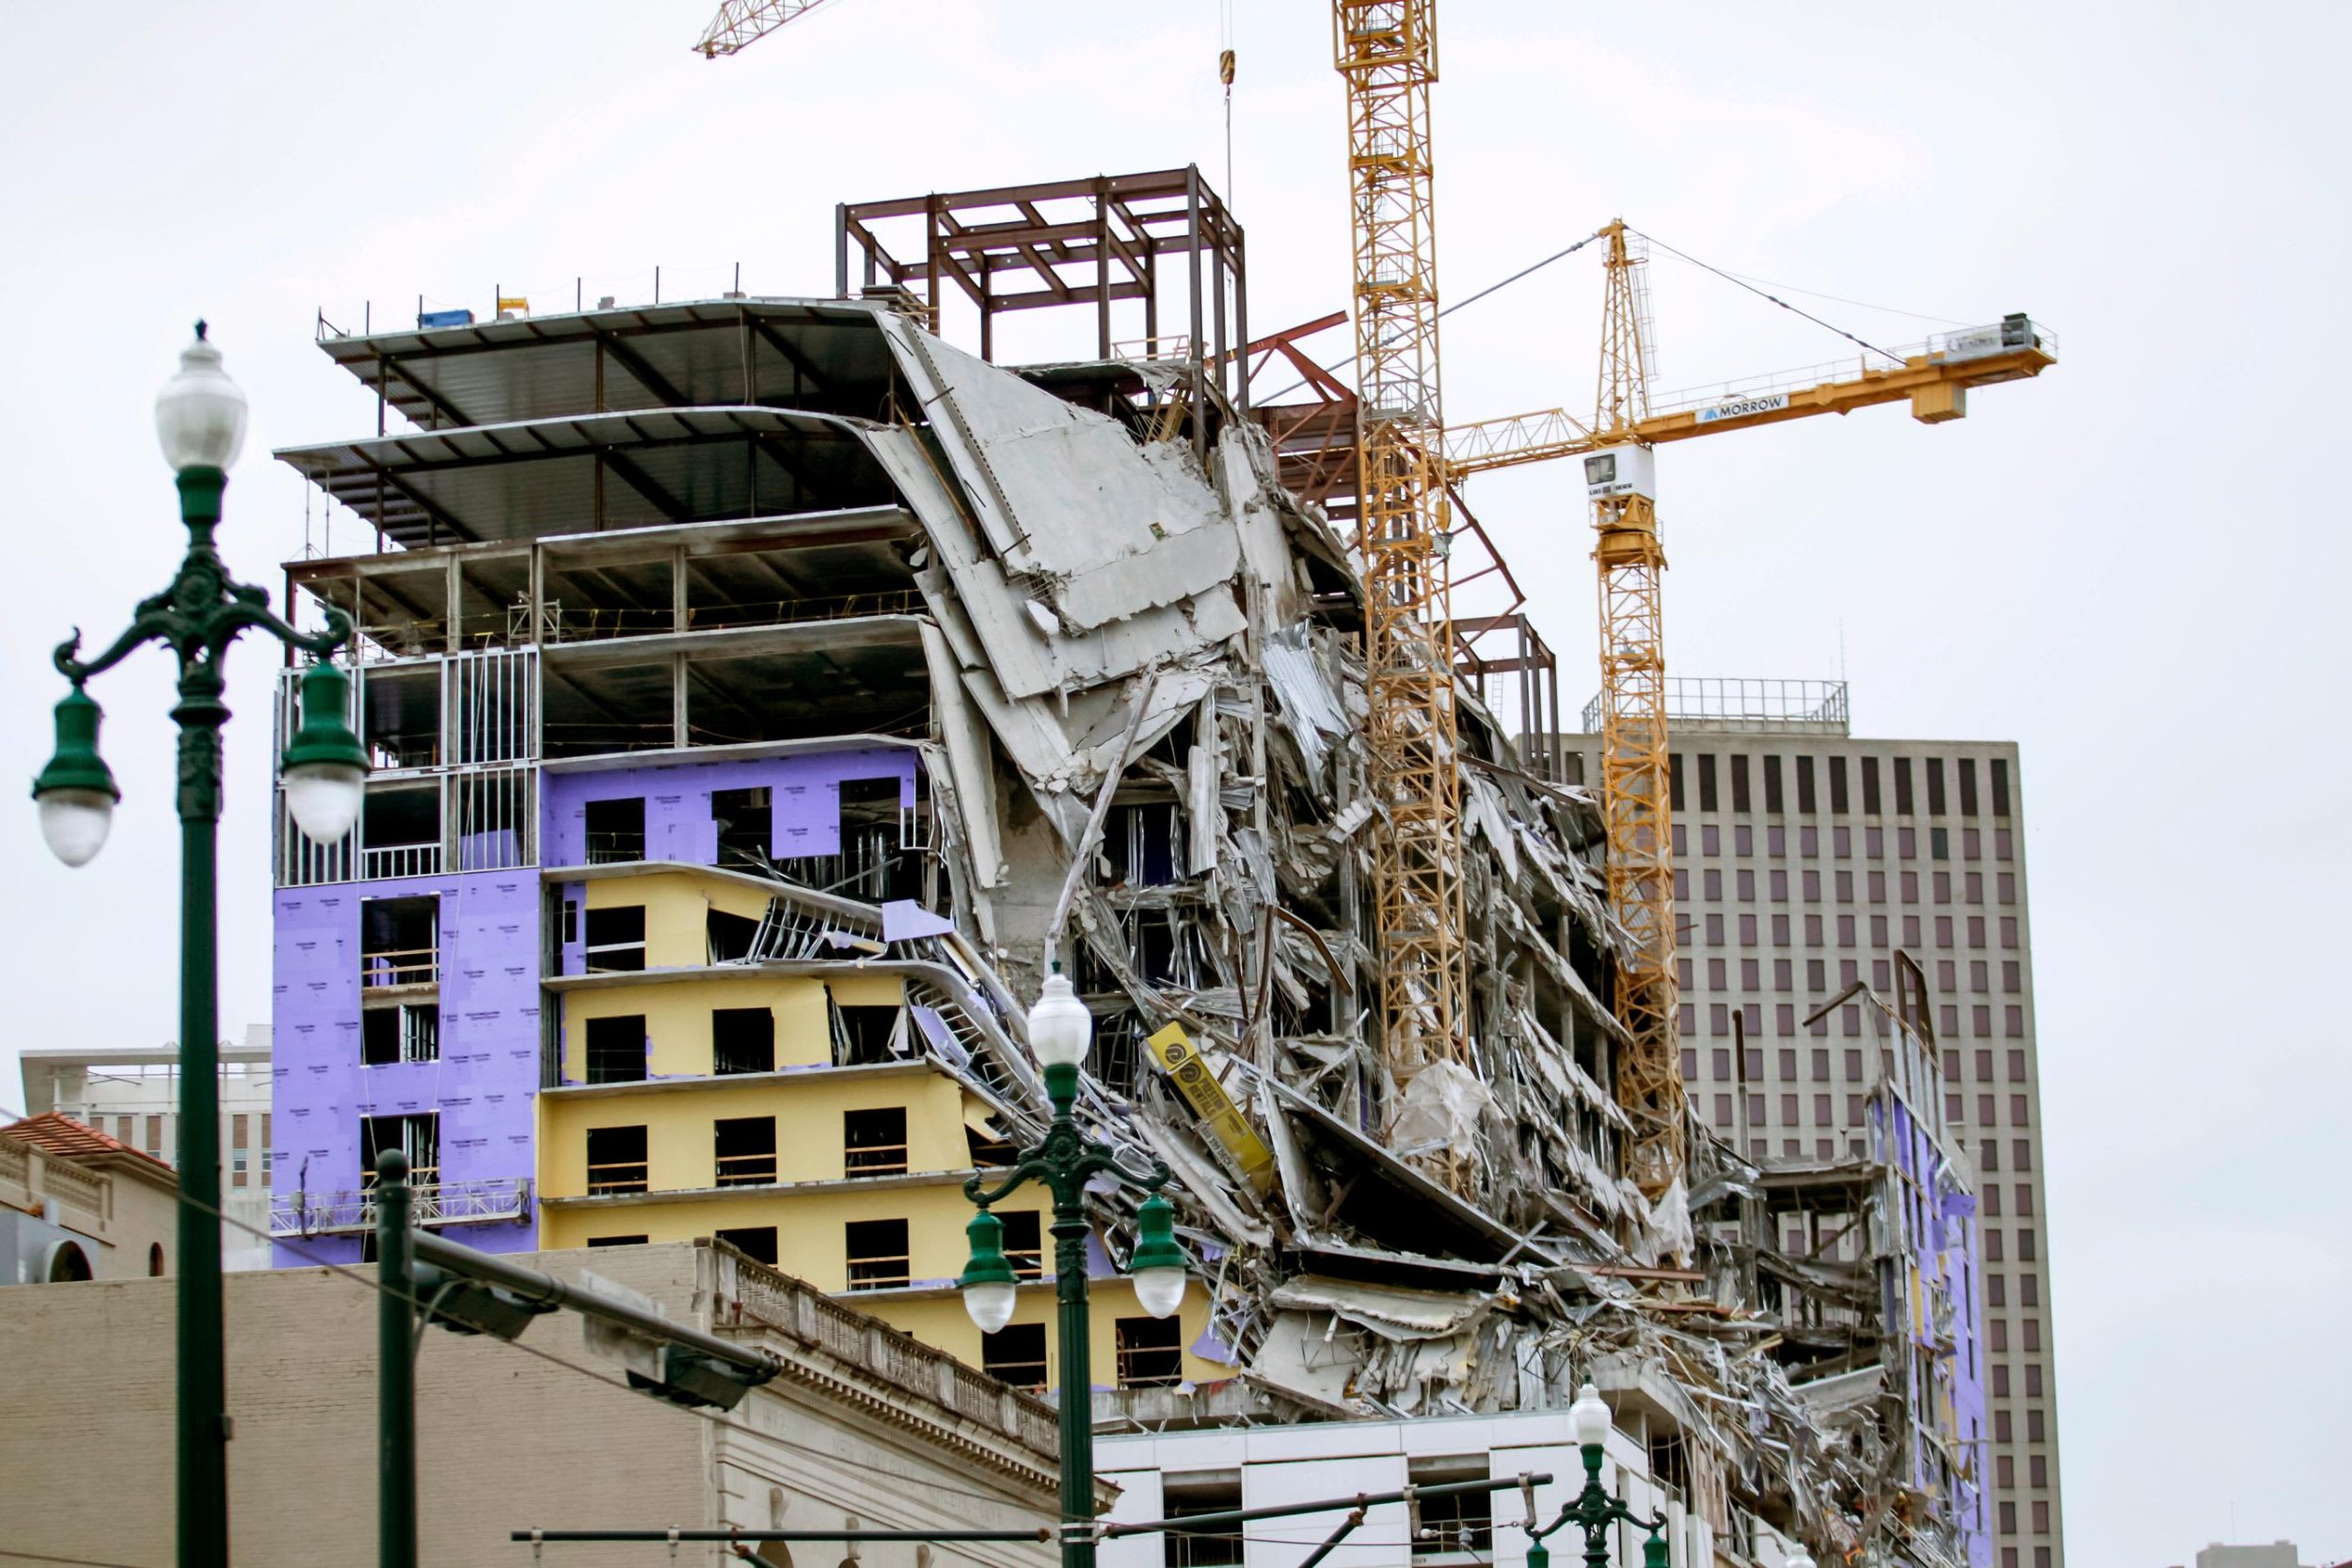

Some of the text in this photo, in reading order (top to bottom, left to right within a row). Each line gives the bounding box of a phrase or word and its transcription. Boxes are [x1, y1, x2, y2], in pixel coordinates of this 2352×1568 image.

[1719, 396, 1782, 417] MORROW
[1188, 1084, 1216, 1117] RENTALS
[1199, 1077, 1225, 1109] PRESTON
